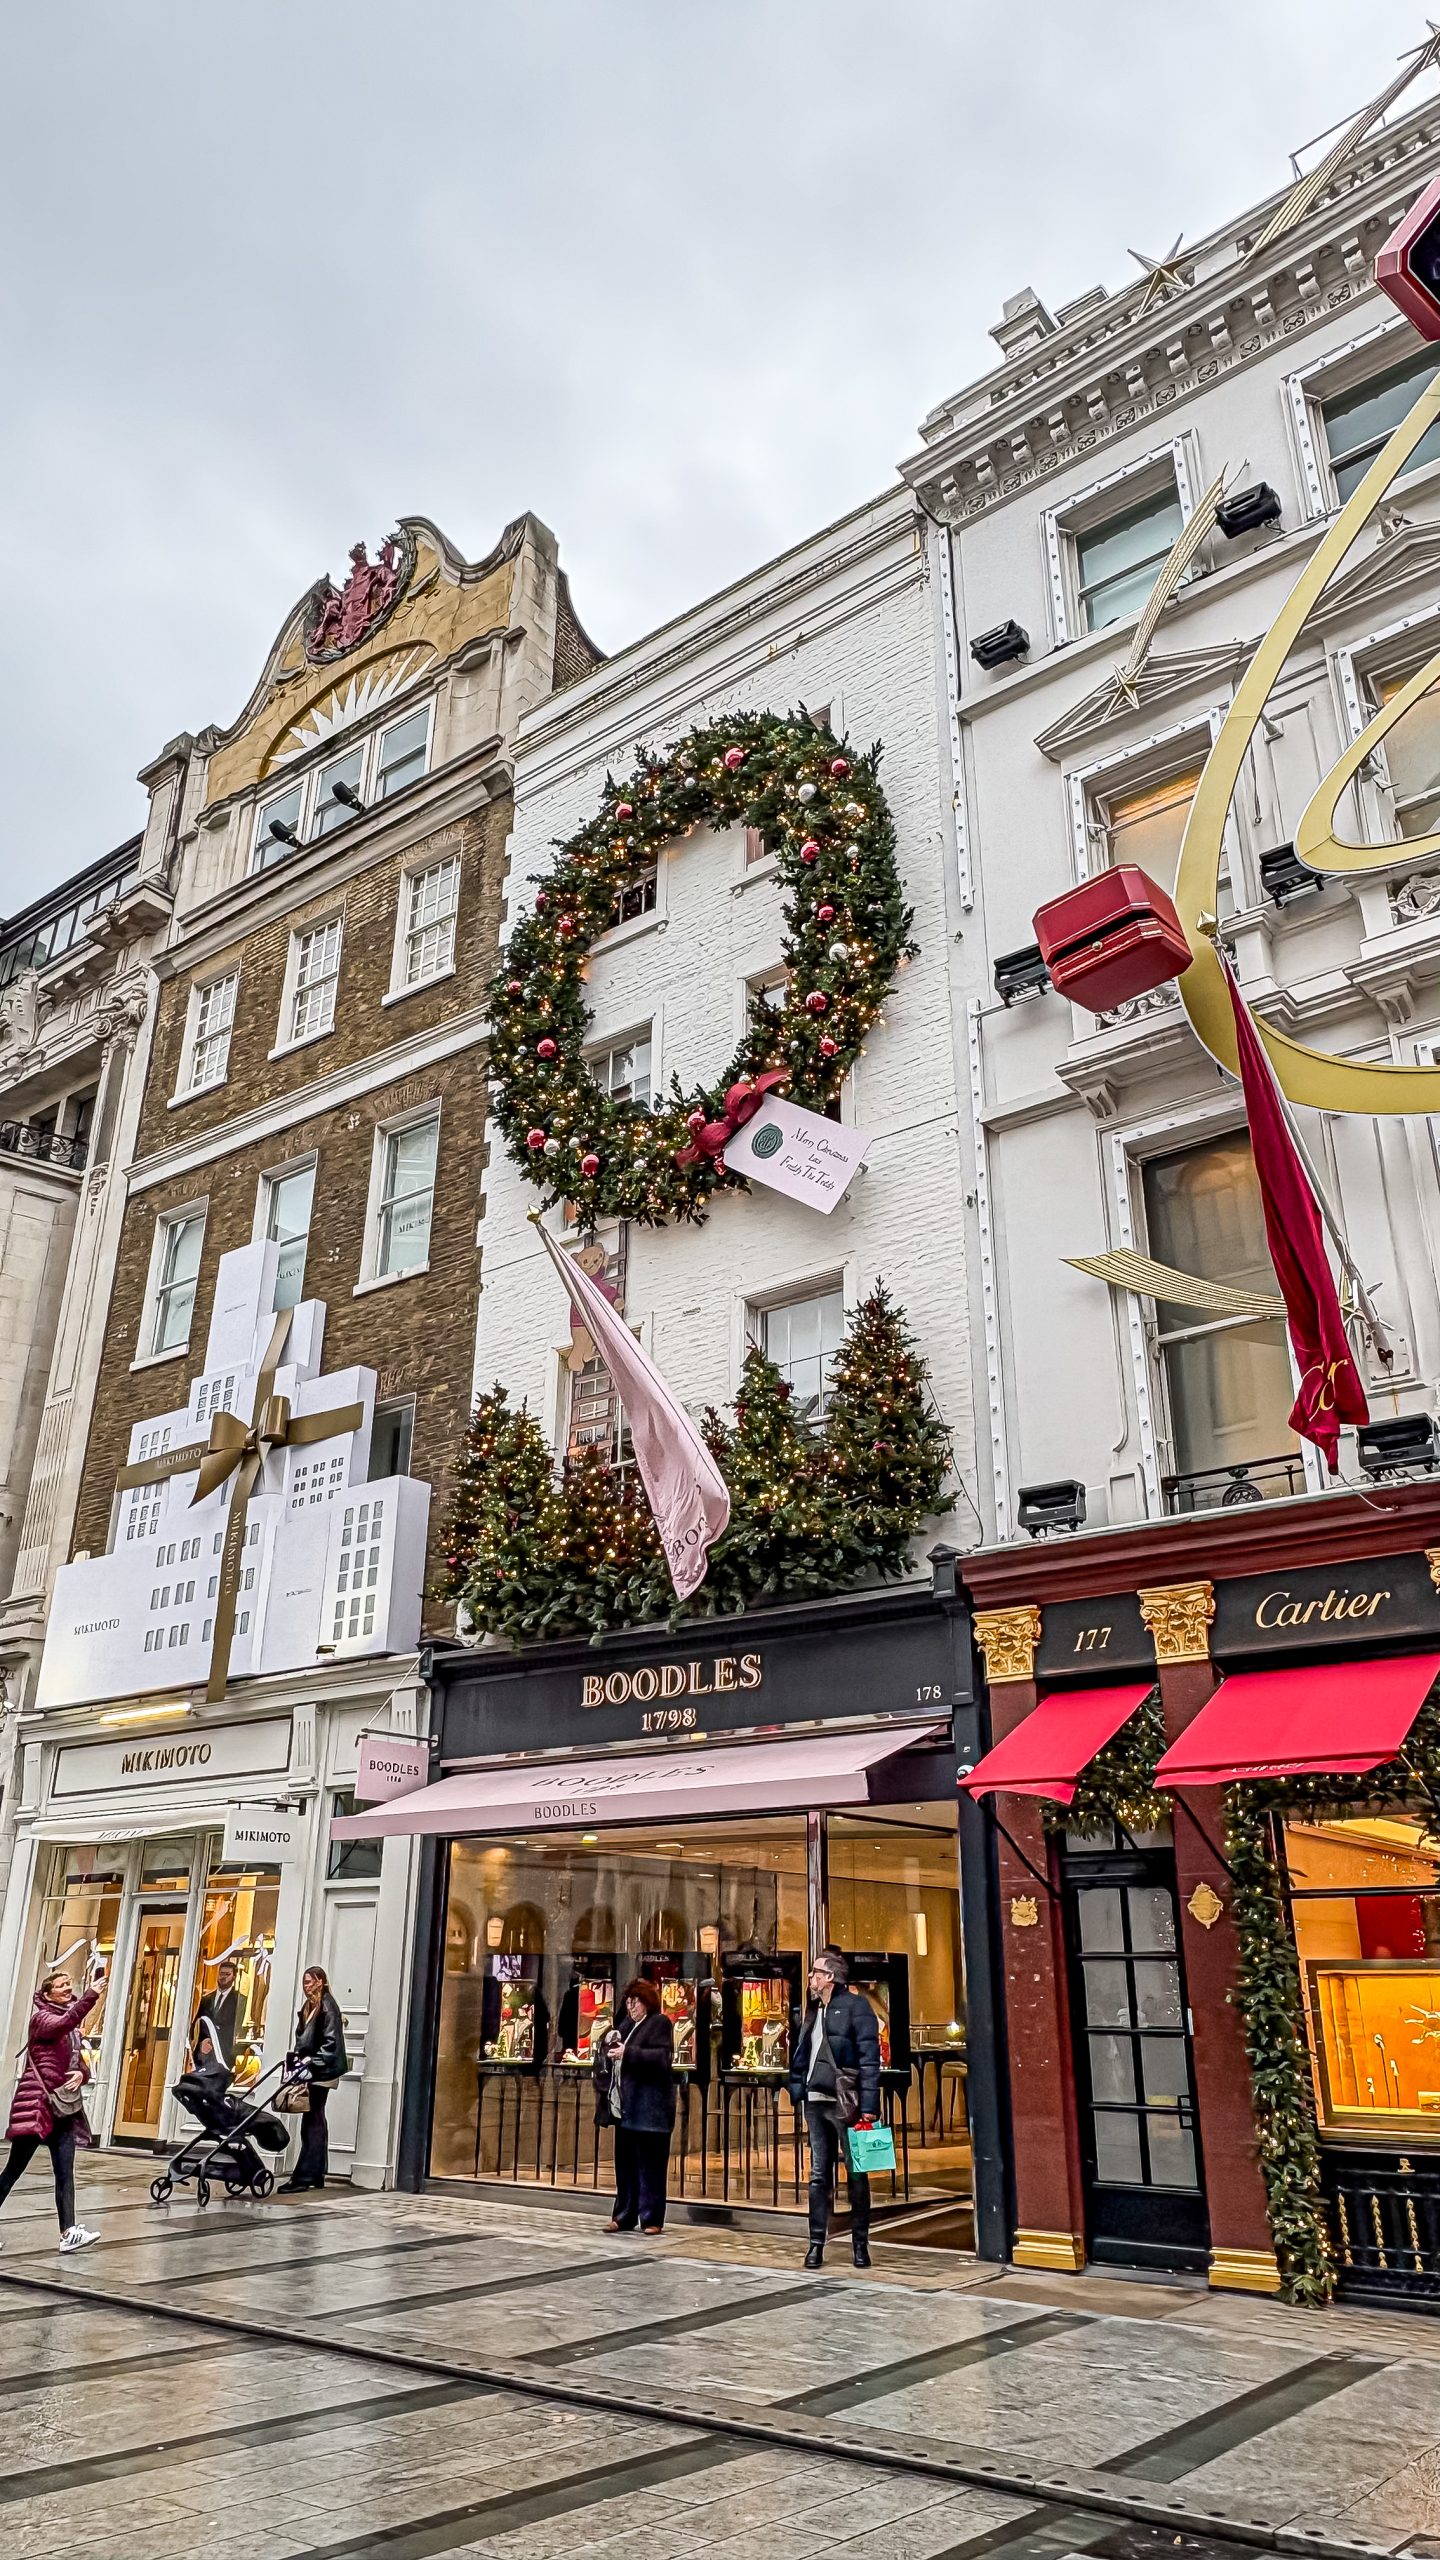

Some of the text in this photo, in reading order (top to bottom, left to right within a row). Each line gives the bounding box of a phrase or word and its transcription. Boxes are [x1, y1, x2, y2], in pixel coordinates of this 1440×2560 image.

[1255, 1589, 1391, 1628] Cartier
[1073, 1627, 1112, 1652] 177
[580, 1654, 762, 1708] BOODLES
[915, 1685, 943, 1702] 178
[641, 1707, 698, 1733] 1798
[121, 1743, 212, 1775] MIKIMOTO
[369, 1759, 419, 1776] BOODLES
[535, 1802, 597, 1820] BOODLES
[235, 1829, 291, 1843] MIKIMOTO
